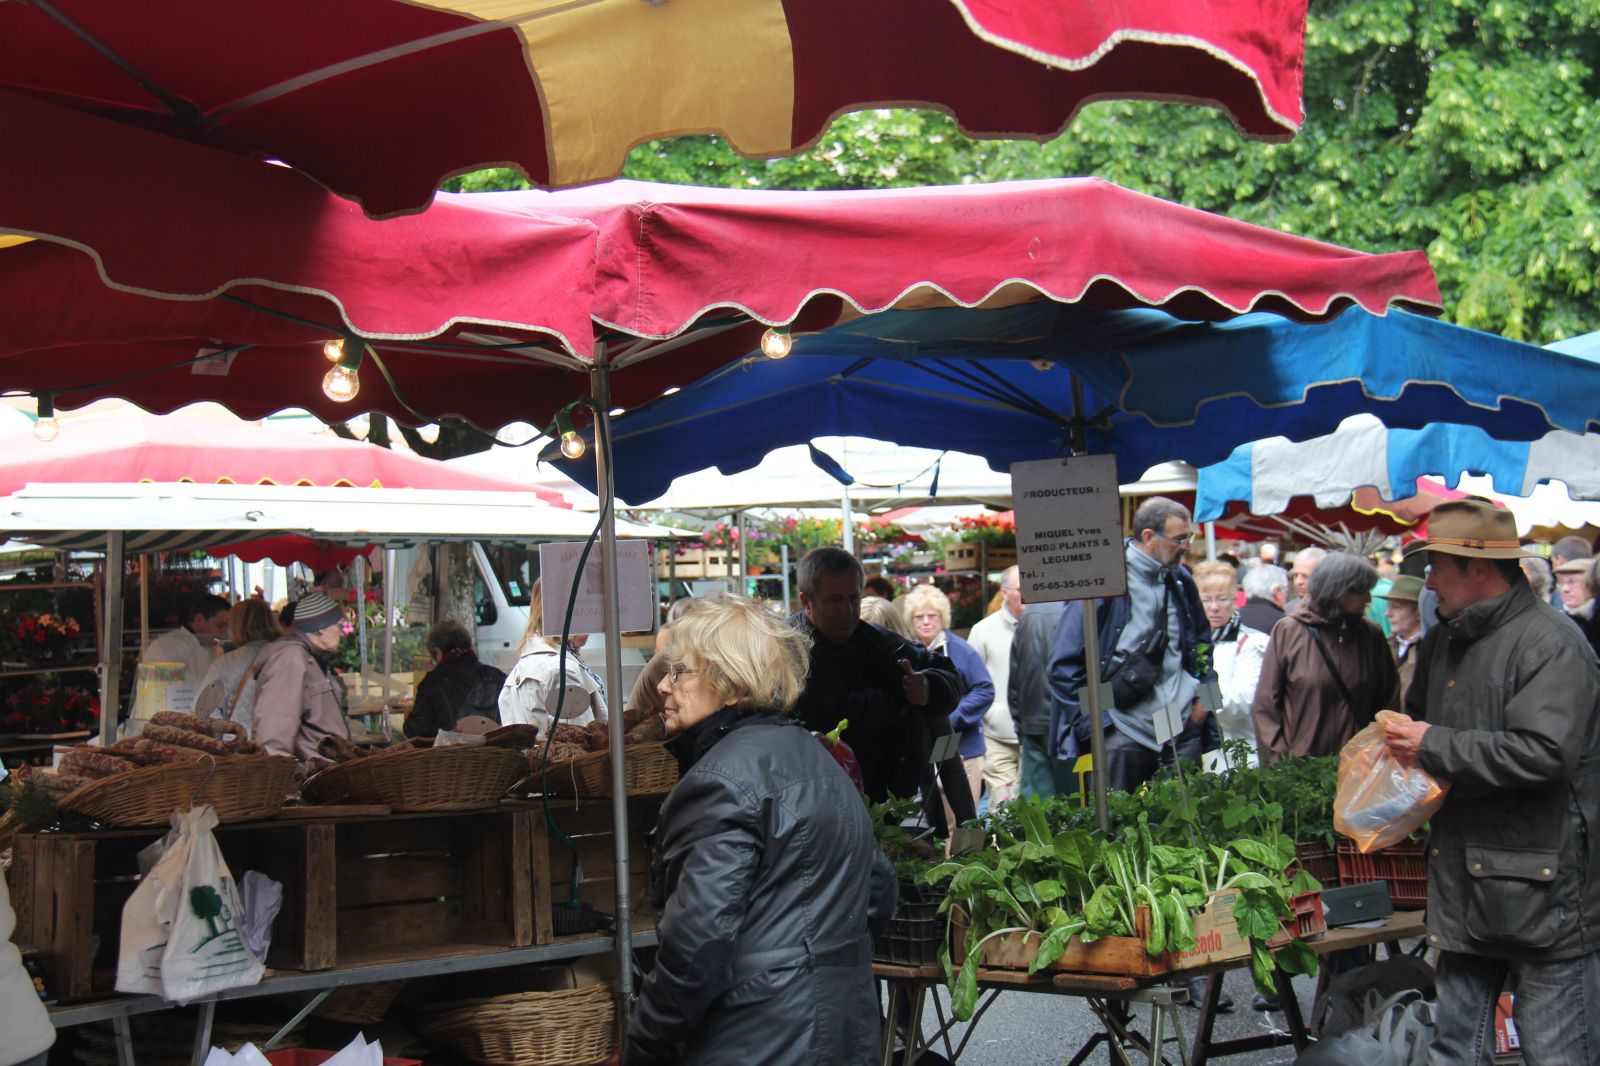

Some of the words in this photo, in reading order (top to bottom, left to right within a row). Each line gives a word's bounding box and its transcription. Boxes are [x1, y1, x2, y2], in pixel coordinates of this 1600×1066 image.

[1023, 486, 1094, 499] PRODUCTEUR
[1034, 529, 1075, 540] MIQUEL
[1077, 528, 1102, 536] Yves
[1021, 543, 1057, 553] VENDS
[1058, 540, 1100, 550] PLANTS
[1103, 538, 1111, 546] &
[1042, 553, 1092, 565] LEGUMES
[1032, 578, 1106, 591] 05-65-35-05-12
